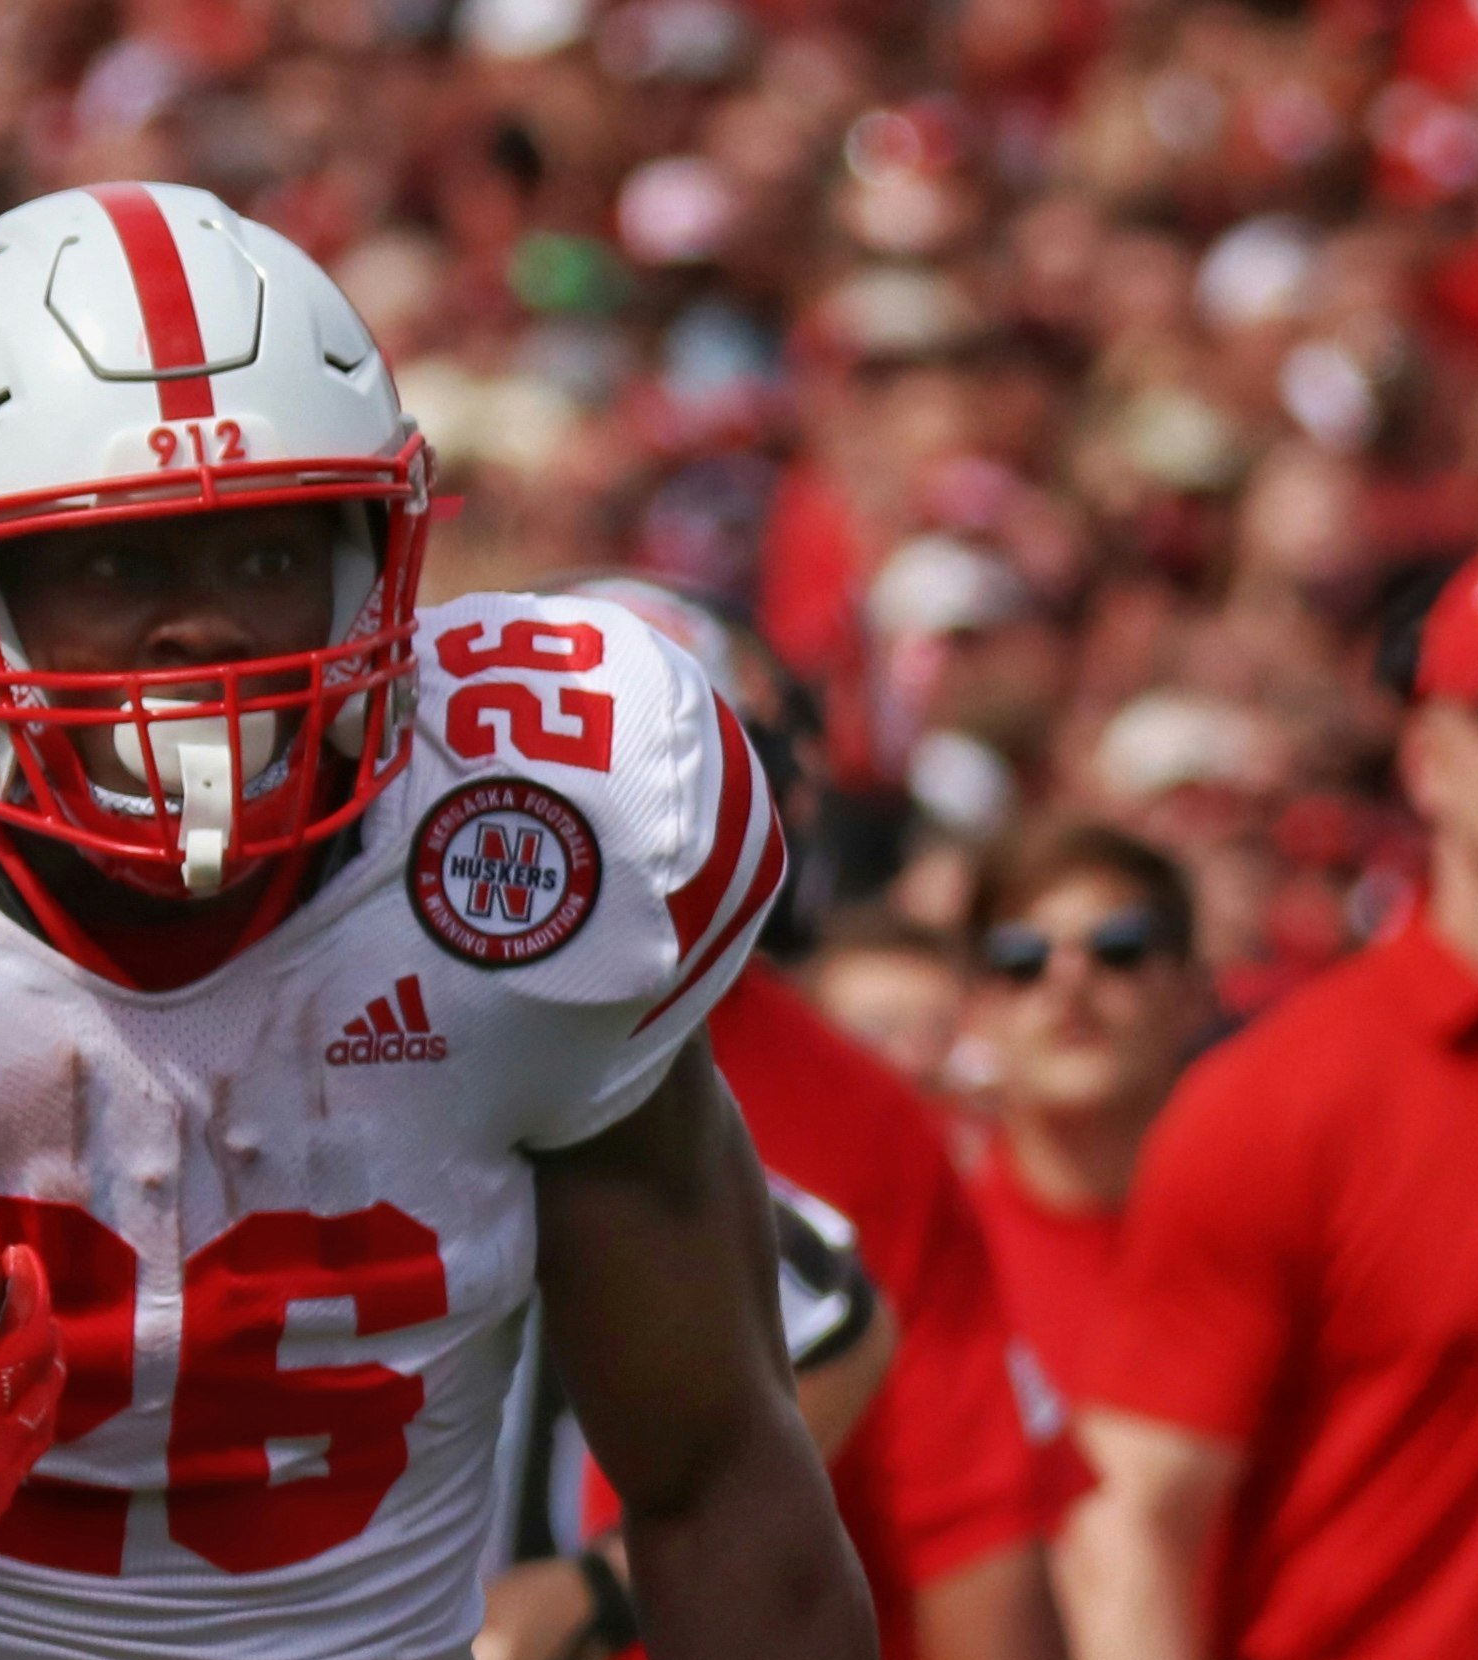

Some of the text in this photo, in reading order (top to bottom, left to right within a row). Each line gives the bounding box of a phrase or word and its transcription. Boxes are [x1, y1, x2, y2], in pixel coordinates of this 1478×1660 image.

[147, 418, 247, 467] 912
[435, 618, 615, 774] 26
[426, 787, 591, 872] NEBRASKA FOOTBALL
[449, 854, 558, 892] HUSKERS
[424, 892, 488, 957] WINNING
[500, 891, 585, 961] TRADITION
[324, 1032, 449, 1067] adidas
